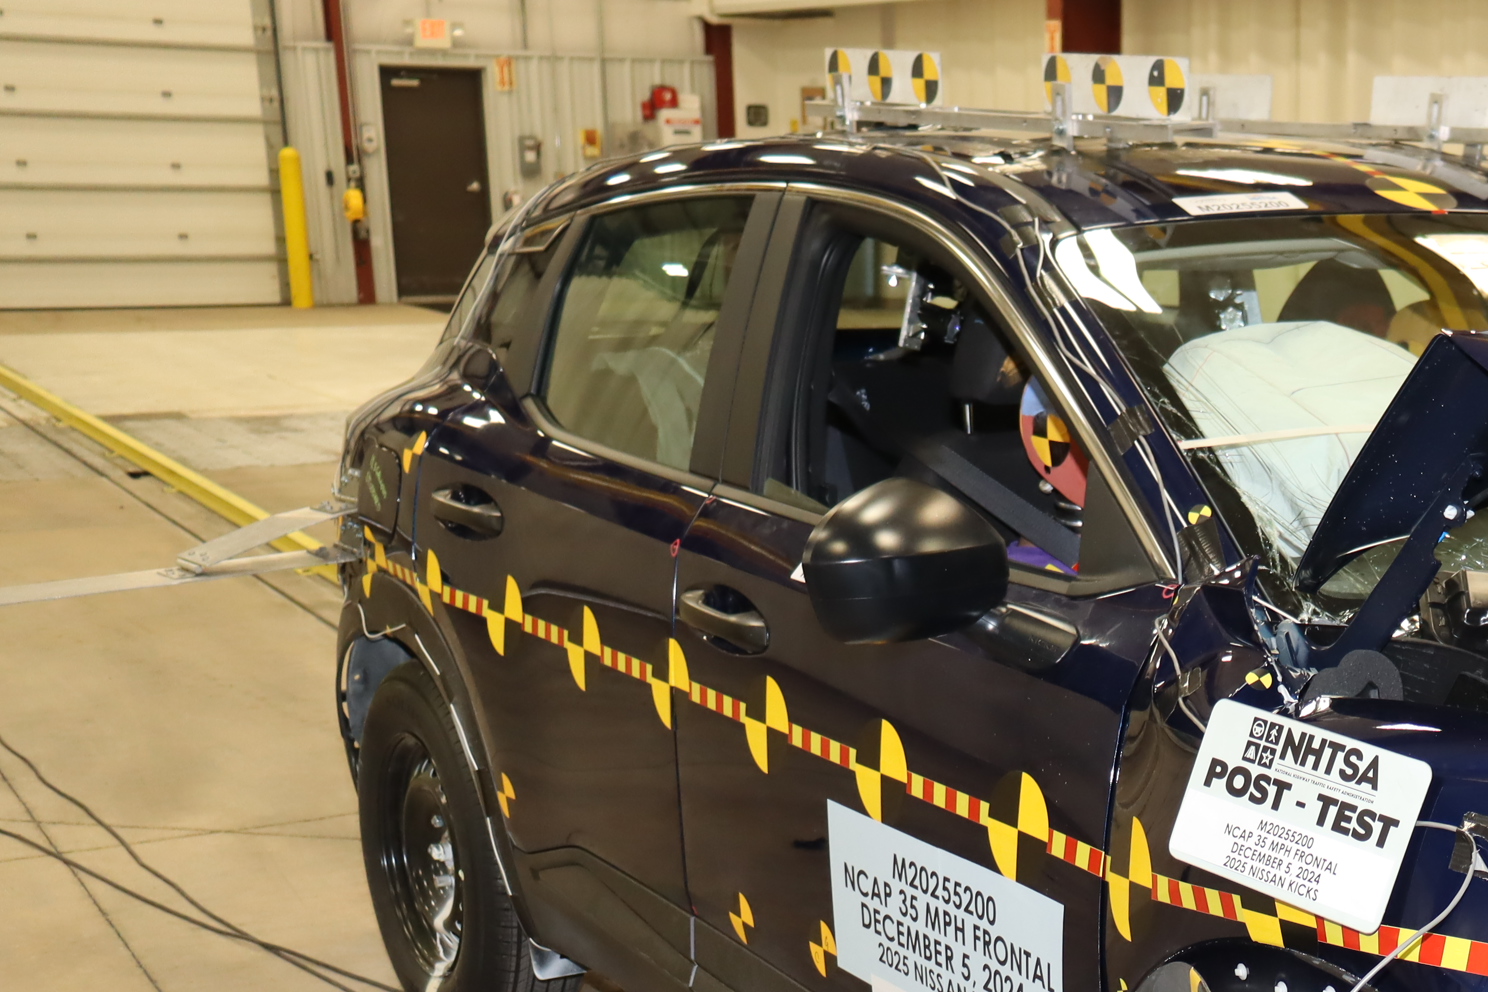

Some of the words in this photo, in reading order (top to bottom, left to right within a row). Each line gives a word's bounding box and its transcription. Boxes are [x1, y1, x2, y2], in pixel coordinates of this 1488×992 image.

[1279, 727, 1380, 791] NHTSA
[1203, 757, 1292, 811] POST
[1315, 793, 1400, 849] TEST
[1224, 823, 1253, 846] NCAP
[1254, 834, 1267, 848] 35
[1269, 839, 1292, 857] MPH
[1293, 848, 1338, 876] FRONTAL
[1257, 819, 1314, 849] M20255200
[892, 853, 996, 926] M20255200
[1223, 856, 1247, 875] 2025
[1248, 867, 1285, 889] NISSAN
[1287, 880, 1319, 902] KICKS
[1230, 842, 1283, 868] DECEMBER
[1284, 861, 1293, 877] 5,
[1297, 866, 1321, 886] 2024
[844, 862, 892, 908] NCAP
[899, 889, 919, 922] 35
[926, 902, 966, 946] MPH
[861, 902, 954, 975] DECEMBER
[961, 951, 977, 991] 5,
[878, 942, 910, 977] 2025
